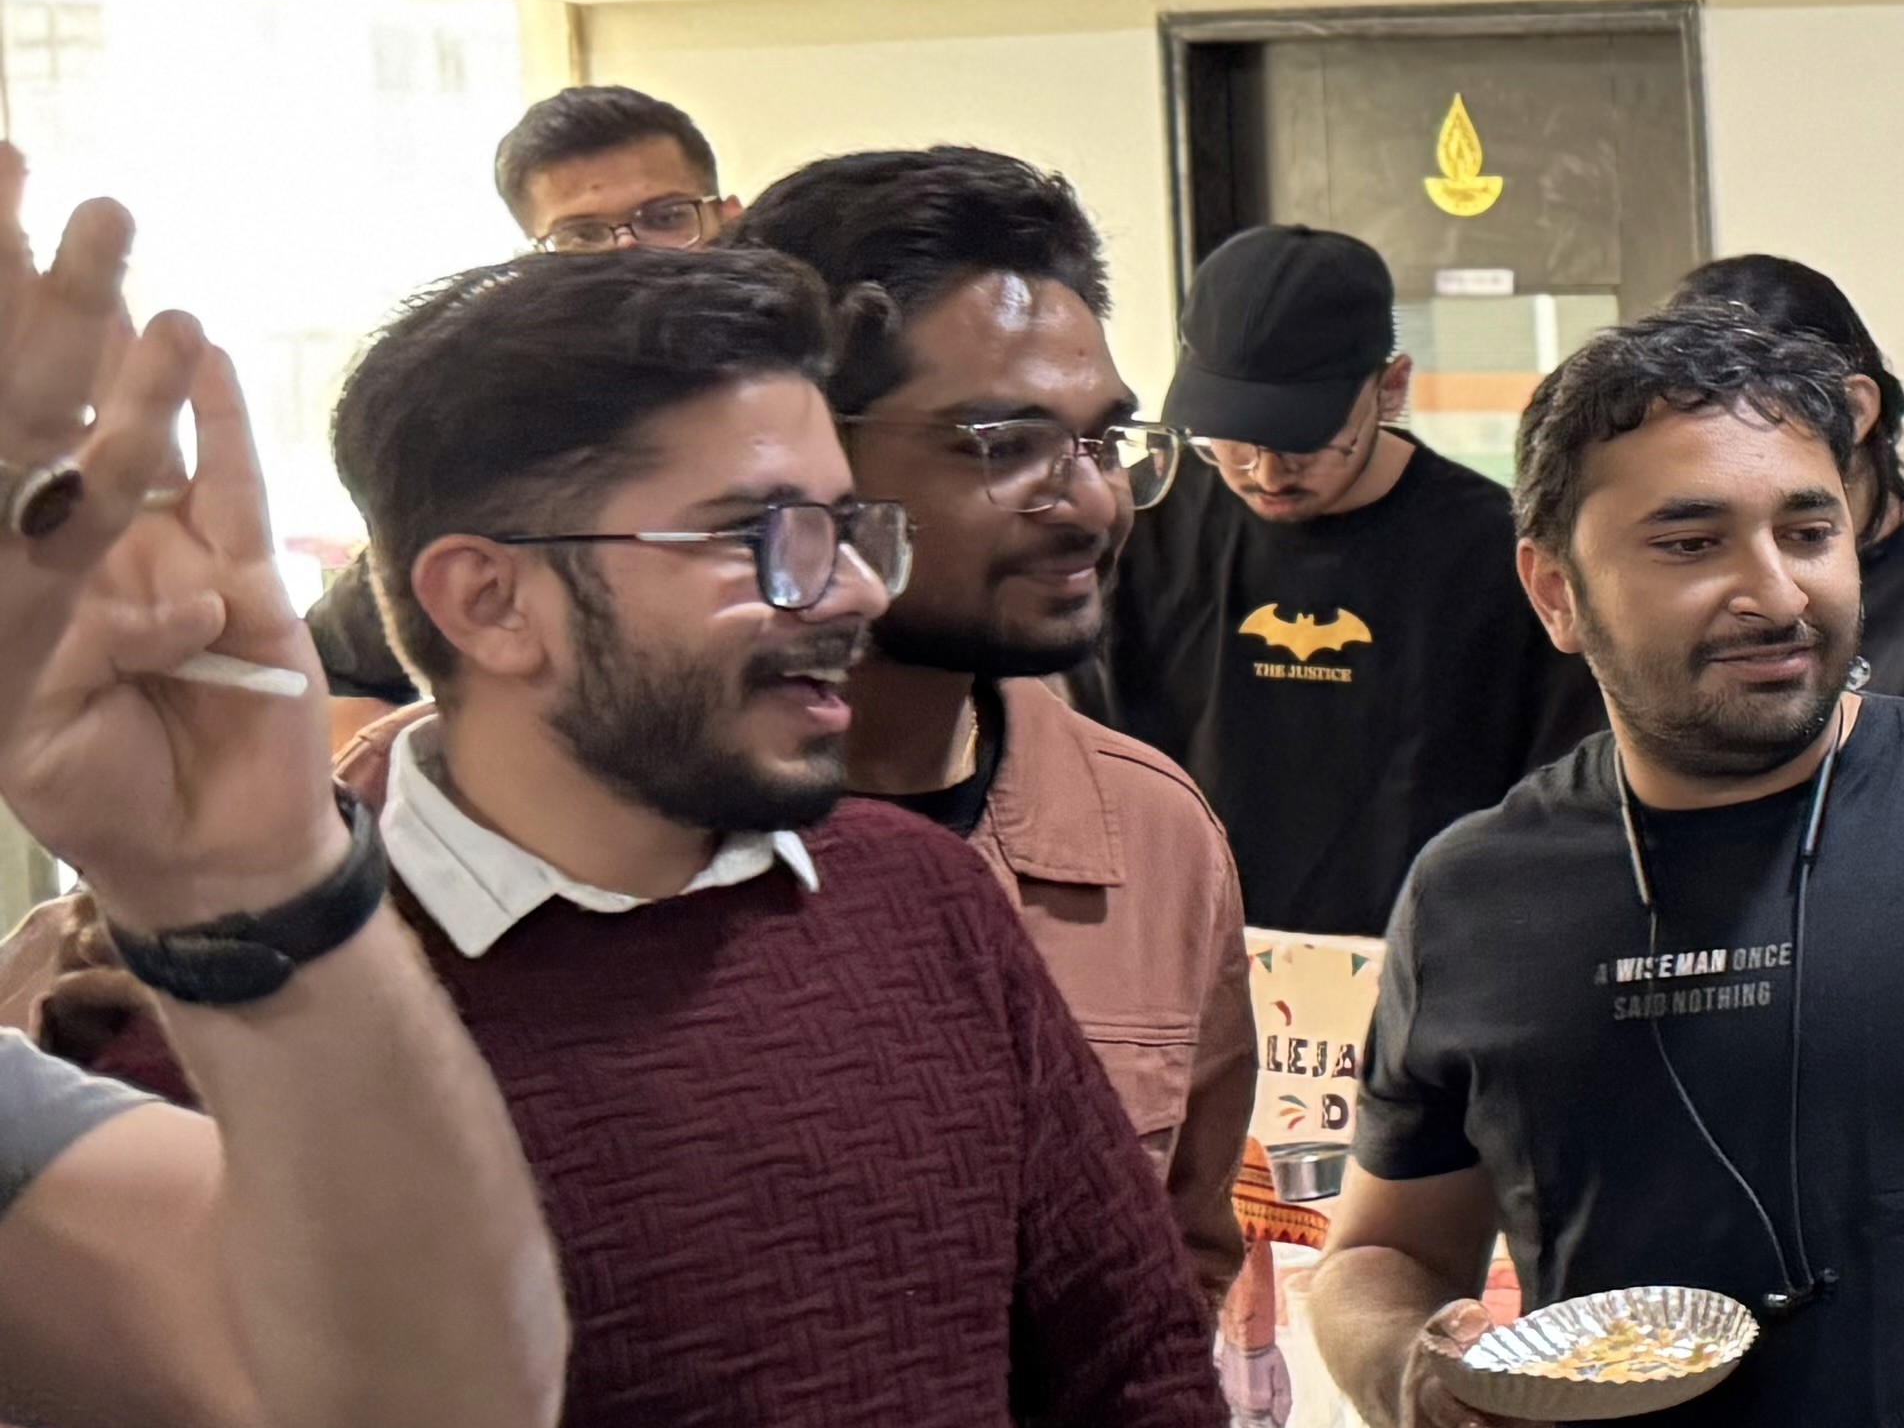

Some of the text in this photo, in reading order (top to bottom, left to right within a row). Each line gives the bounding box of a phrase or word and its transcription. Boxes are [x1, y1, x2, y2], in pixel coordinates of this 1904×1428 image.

[1254, 662, 1352, 682] THE JUSTICE
[1732, 942, 1793, 971] ONCE
[1613, 981, 1771, 1021] SAID NOTHING
